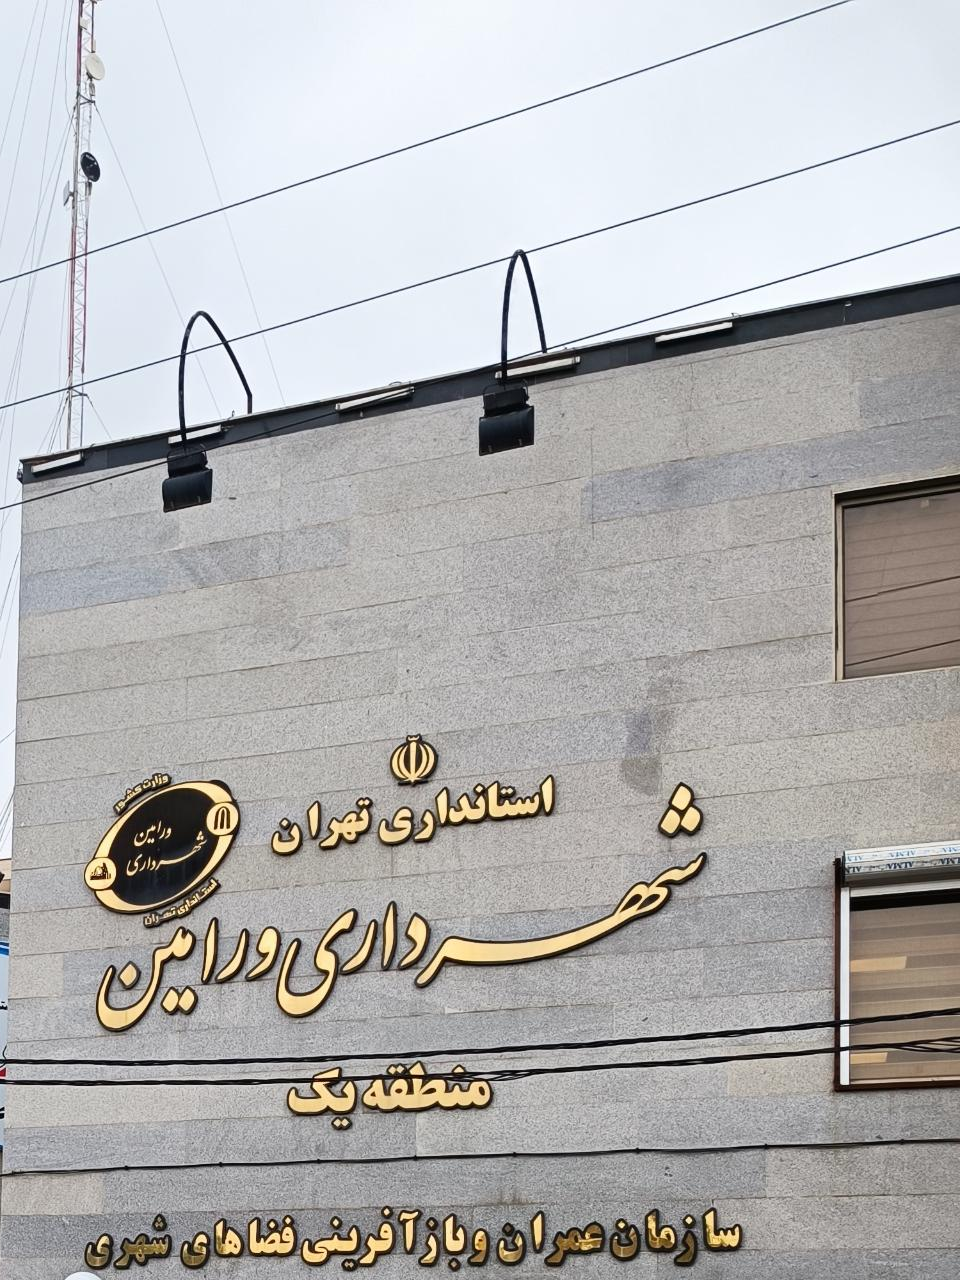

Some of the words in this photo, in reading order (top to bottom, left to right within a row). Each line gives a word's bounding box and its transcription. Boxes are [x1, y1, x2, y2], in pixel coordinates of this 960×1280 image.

[113, 781, 143, 815] کشور
[142, 772, 172, 791] وزارت
[378, 774, 556, 846] استانداری
[126, 830, 208, 877] شهرداری
[133, 819, 172, 847] ورامین
[270, 797, 373, 855] تهران
[143, 907, 177, 928] تهران
[176, 876, 221, 917] استانداری
[276, 782, 707, 1018] شهرداری
[96, 917, 281, 1032] ورامین
[287, 1067, 358, 1130] یک
[362, 1061, 495, 1112] منطقه
[84, 1213, 172, 1270] شهری
[496, 1210, 606, 1267] عمران
[611, 1207, 743, 1267] سازمان
